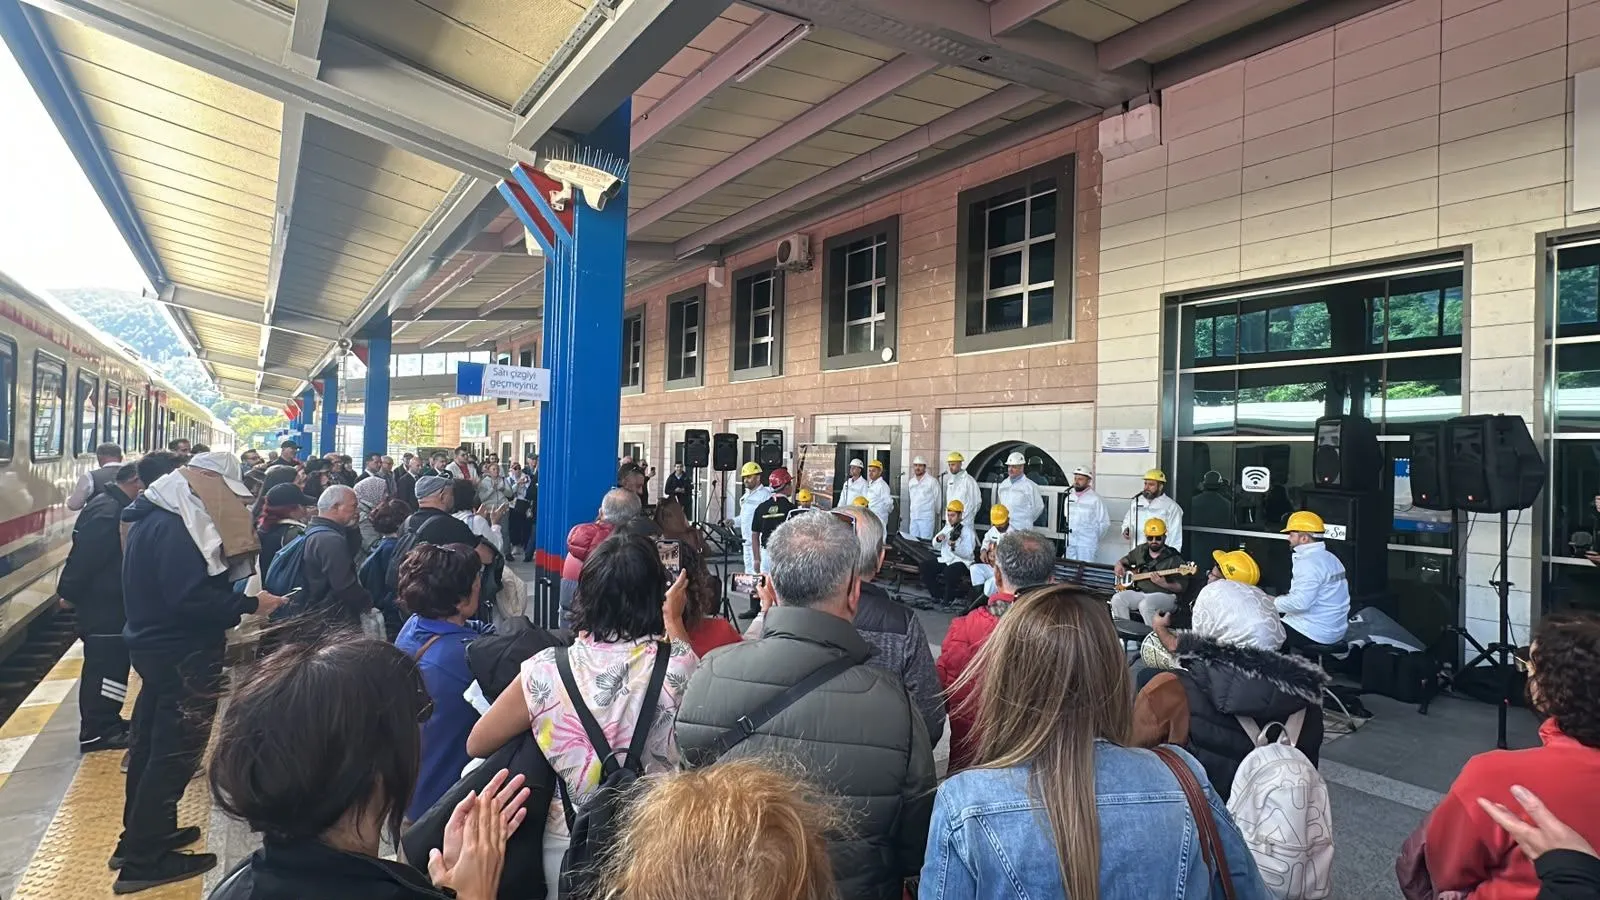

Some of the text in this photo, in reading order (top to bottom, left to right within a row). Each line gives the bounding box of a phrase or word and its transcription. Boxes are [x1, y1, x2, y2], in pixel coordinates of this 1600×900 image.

[493, 367, 536, 381] Sarı çizgiyi
[490, 379, 538, 391] geçmeyiniz
